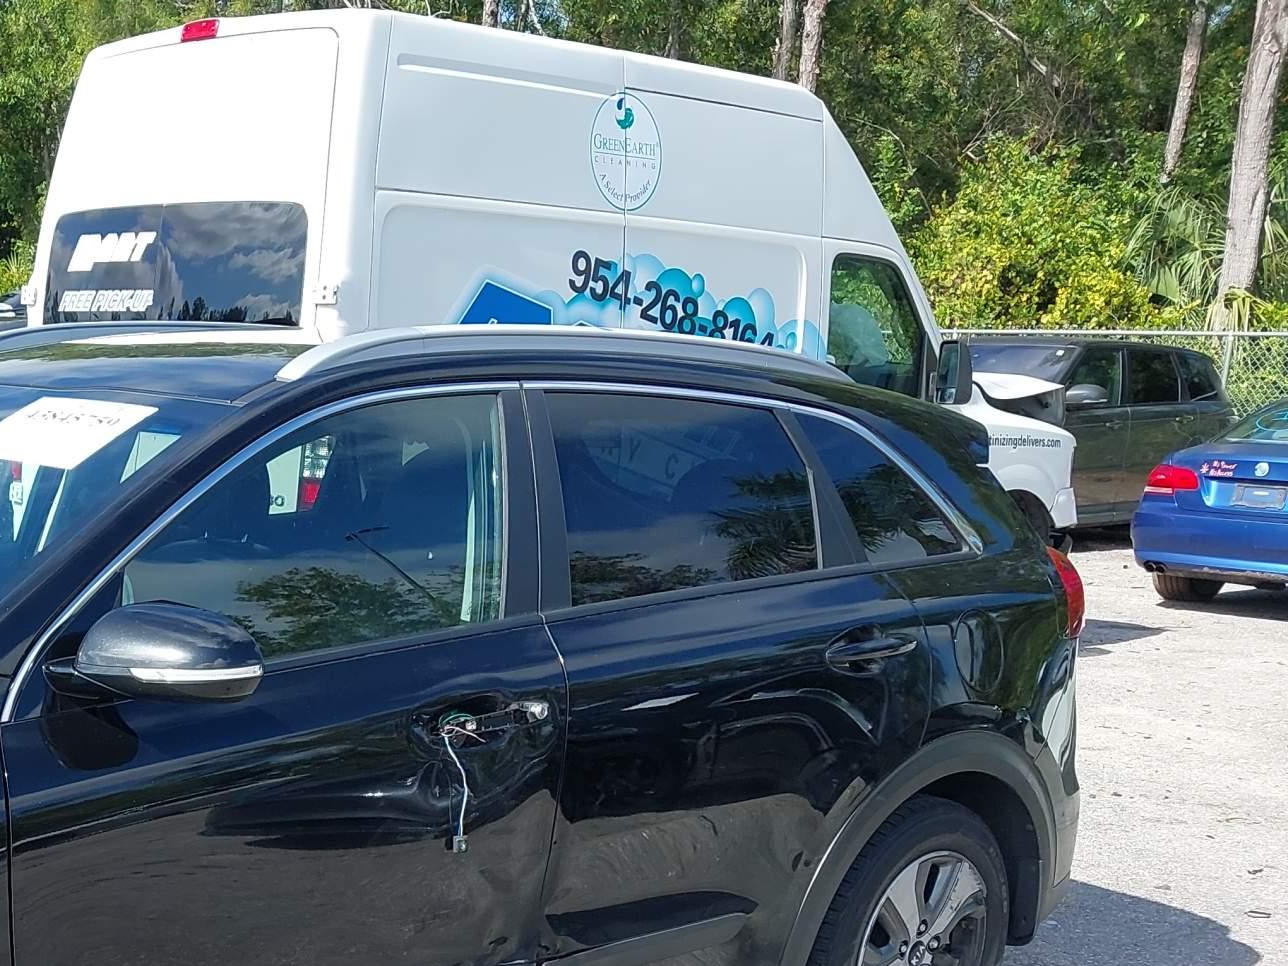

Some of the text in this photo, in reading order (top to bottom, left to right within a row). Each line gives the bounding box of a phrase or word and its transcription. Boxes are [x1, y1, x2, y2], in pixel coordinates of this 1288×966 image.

[594, 155, 656, 170] CLEANING
[604, 180, 624, 202] Select
[624, 179, 651, 203] Provider
[58, 289, 154, 312] FREE PICK-UP
